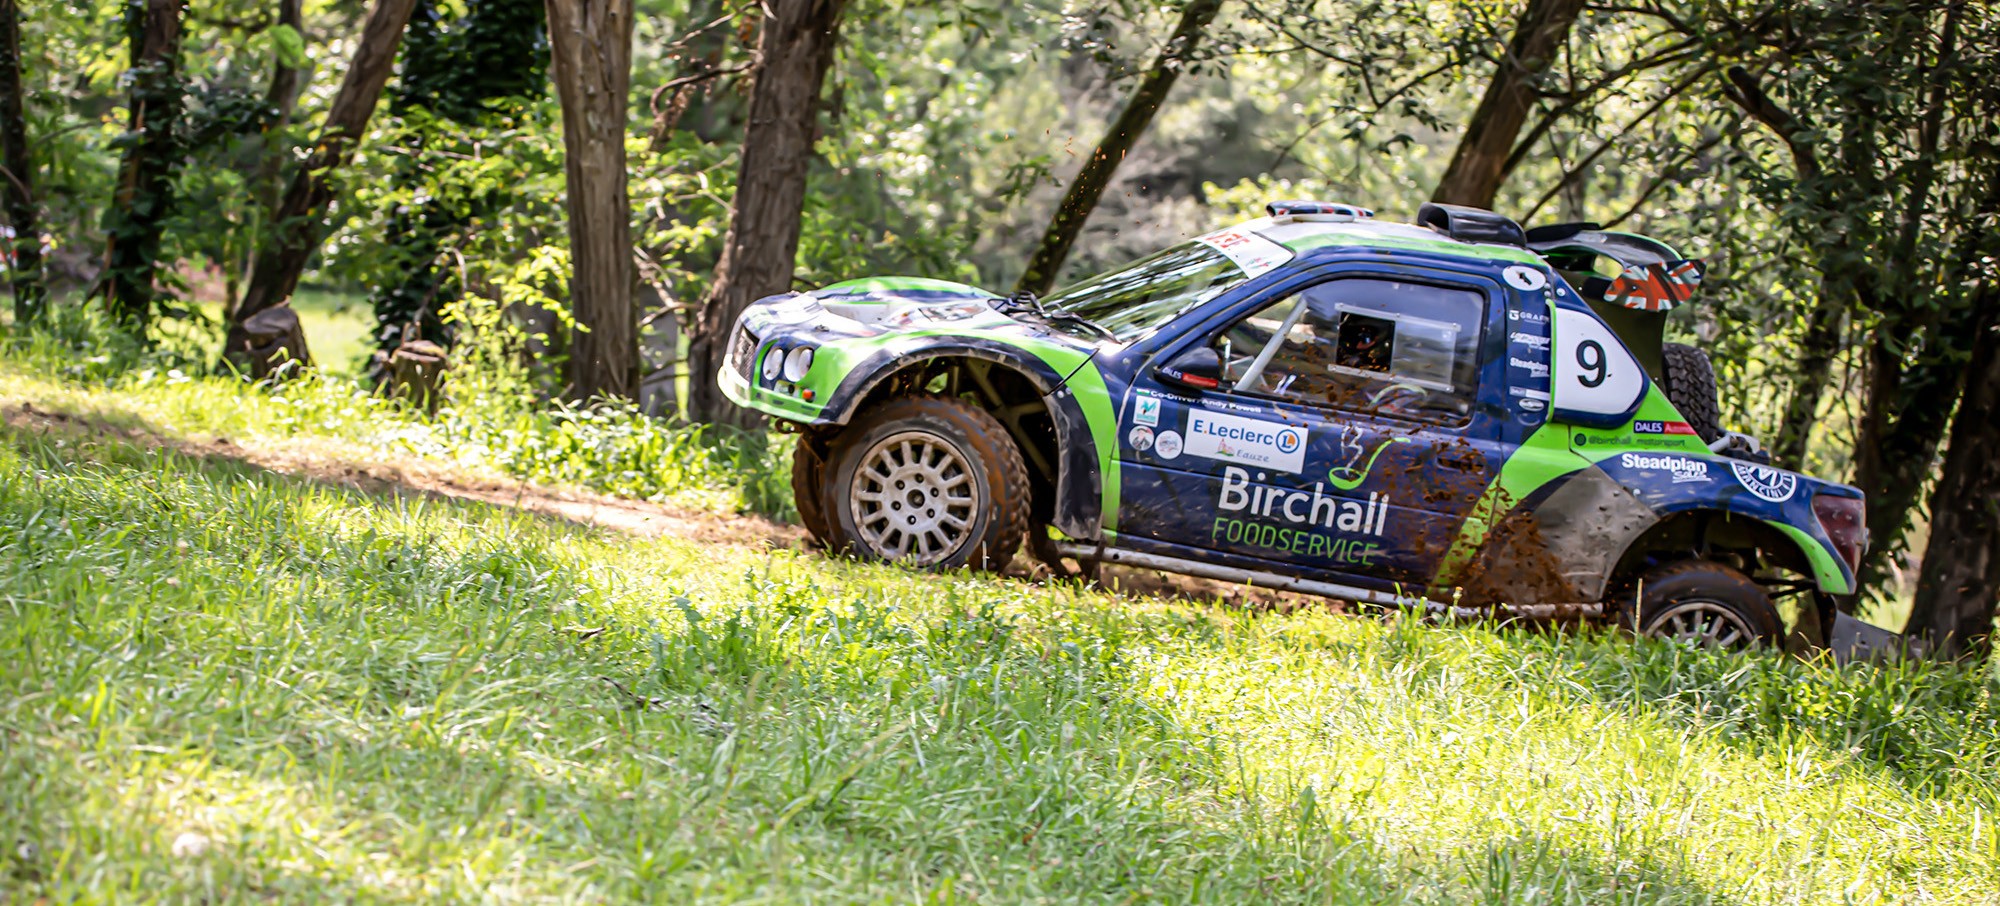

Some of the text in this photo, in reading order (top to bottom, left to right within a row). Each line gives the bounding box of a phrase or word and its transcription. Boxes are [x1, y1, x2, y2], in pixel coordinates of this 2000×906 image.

[1575, 339, 1607, 388] 9
[1202, 398, 1229, 410] Andy
[1229, 401, 1262, 414] Powell
[1193, 419, 1273, 446] E.Leclerc
[1634, 421, 1663, 433] DALES
[1236, 449, 1270, 463] Eauze
[1621, 453, 1708, 474] Steadplan
[1218, 465, 1390, 537] Birchall
[1211, 516, 1379, 567] FOODSERVICE
